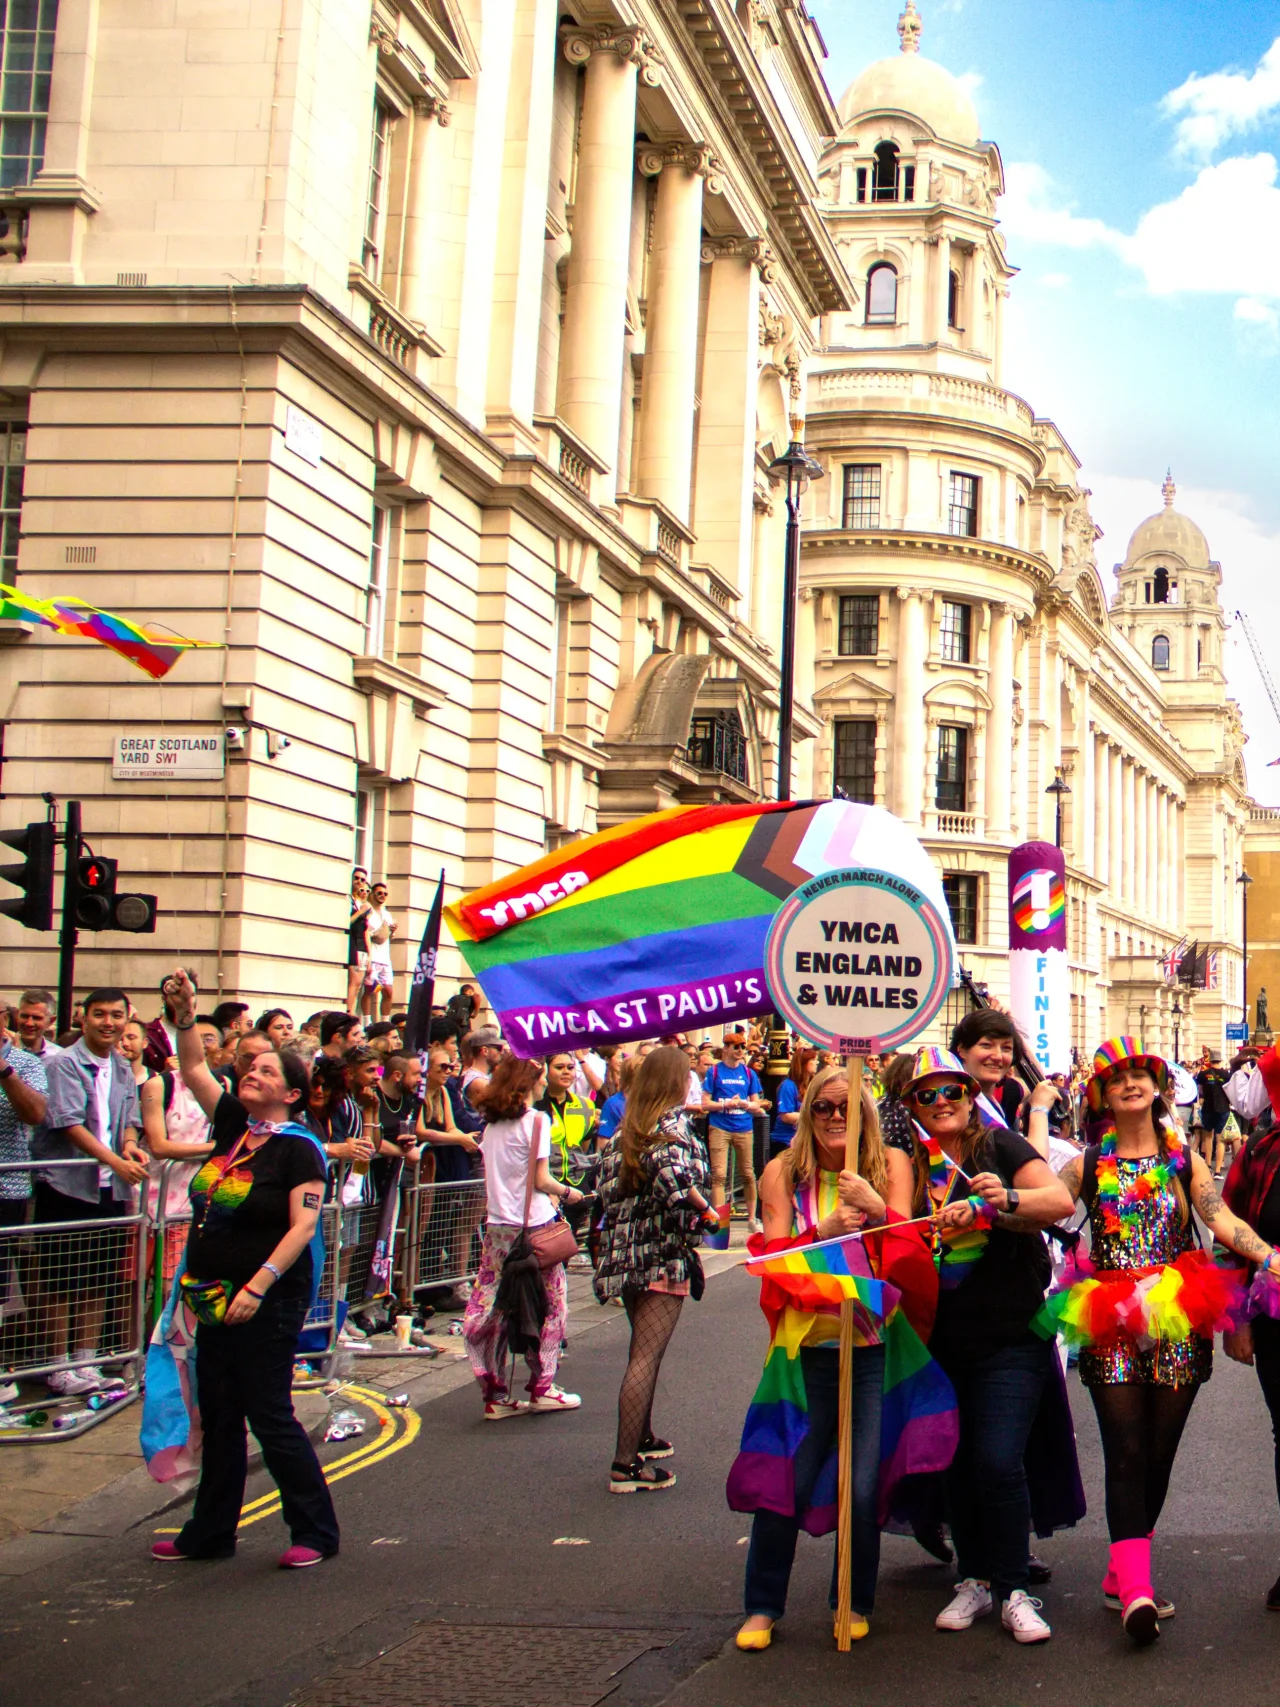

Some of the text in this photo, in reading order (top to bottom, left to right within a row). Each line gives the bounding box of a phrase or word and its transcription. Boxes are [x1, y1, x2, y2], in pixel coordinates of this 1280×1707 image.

[120, 738, 217, 750] GREAT SCOTLAND
[120, 752, 177, 764] YARD SW1
[802, 871, 920, 903] NEVER MARCH ALONE
[820, 920, 899, 944] YMCA
[795, 951, 922, 977] ENGLAND
[796, 983, 918, 1009] & WALES
[514, 978, 762, 1041] YMCA ST PAUL'S
[1035, 957, 1050, 1068] FINISH
[722, 1078, 745, 1086] STEWARD
